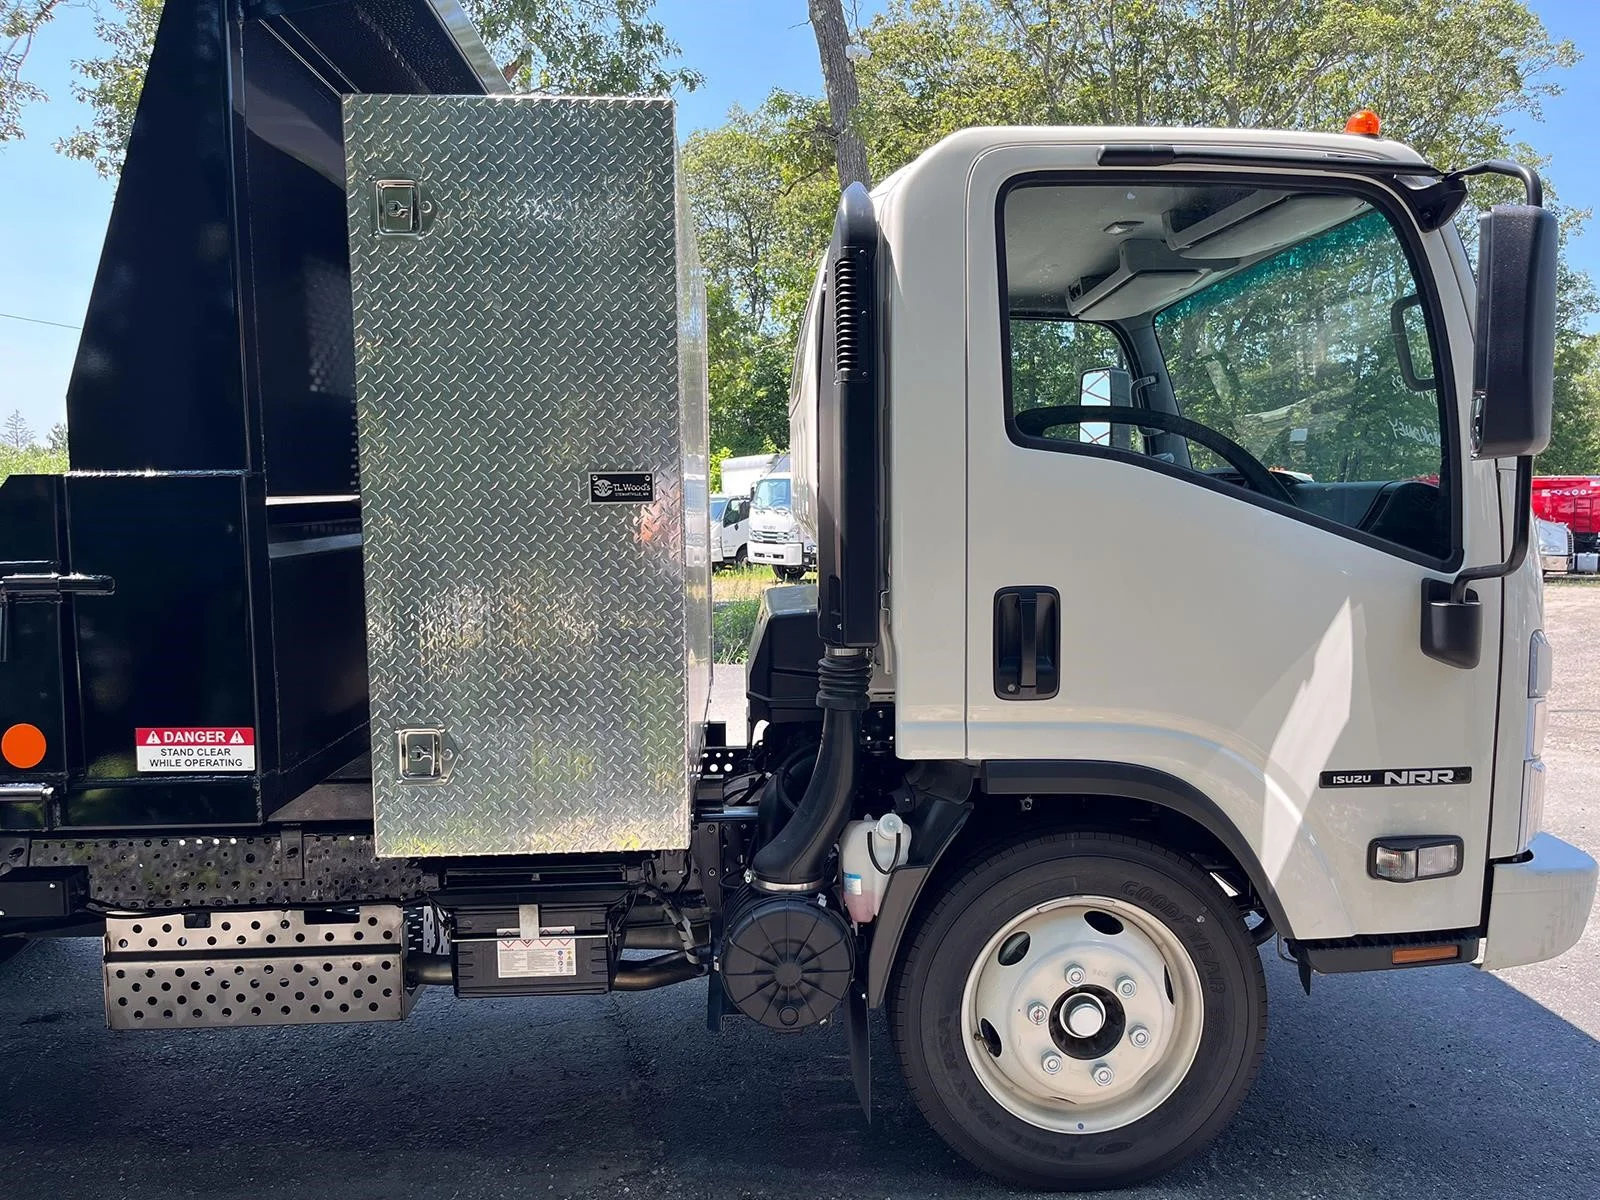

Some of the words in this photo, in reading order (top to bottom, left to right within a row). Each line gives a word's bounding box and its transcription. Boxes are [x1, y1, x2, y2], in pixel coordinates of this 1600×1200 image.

[164, 731, 226, 743] DANGER
[160, 748, 194, 757] STAND
[197, 748, 231, 756] CLEAR
[149, 759, 181, 767] WHILE
[184, 758, 243, 767] OPERATING
[1332, 775, 1372, 784] ISUZU
[1384, 769, 1453, 785] NRR
